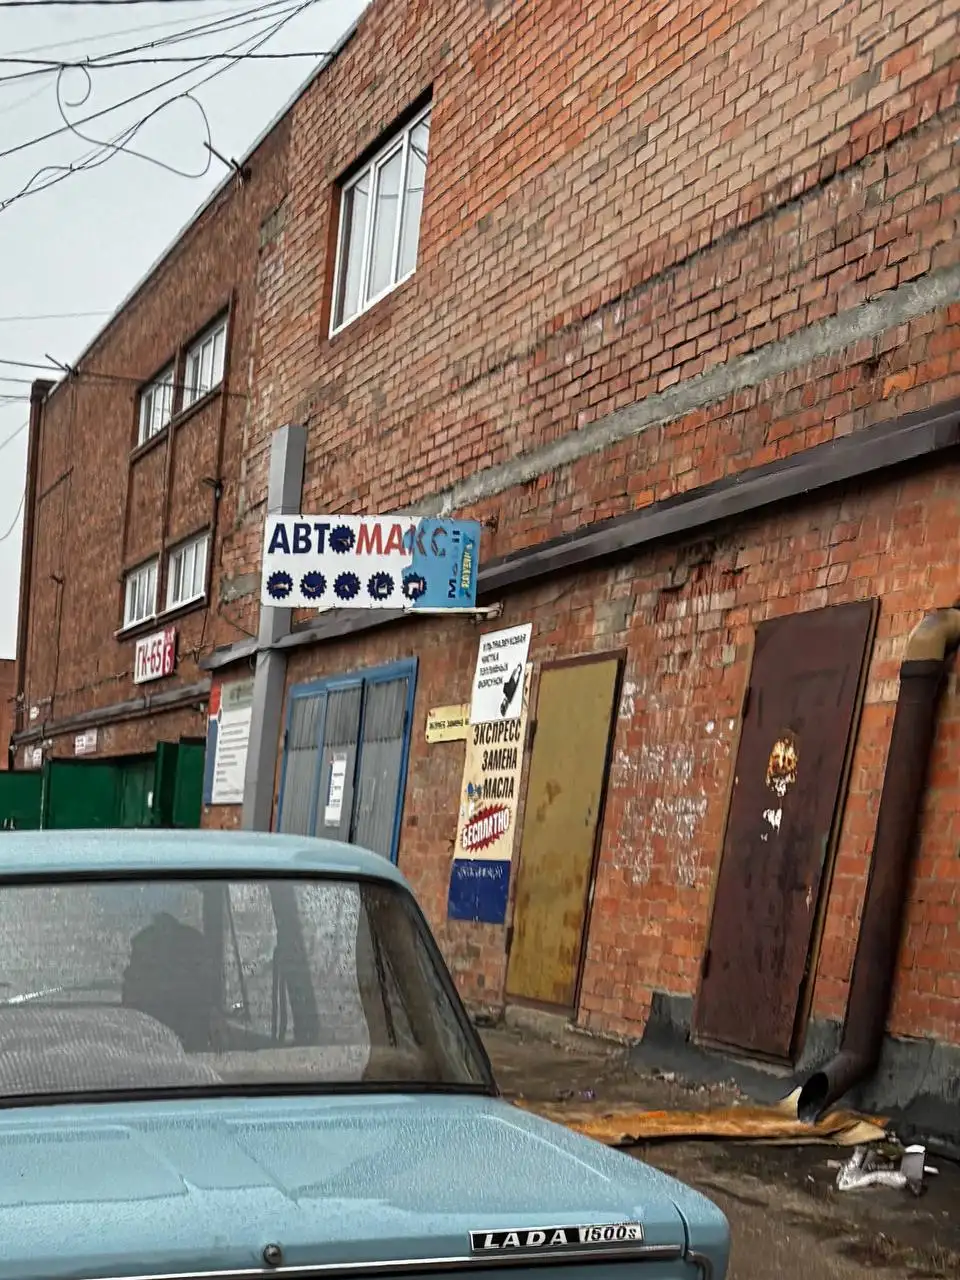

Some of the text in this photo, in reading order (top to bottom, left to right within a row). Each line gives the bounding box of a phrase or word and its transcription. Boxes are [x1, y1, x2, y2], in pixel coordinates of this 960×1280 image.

[474, 719, 521, 745] ЭКСПРЕСС
[482, 748, 517, 771] ЗАМЕНА
[483, 777, 514, 799] МАСЛА
[462, 808, 510, 848] БЕСПЛАТНО
[483, 1229, 568, 1249] LADA
